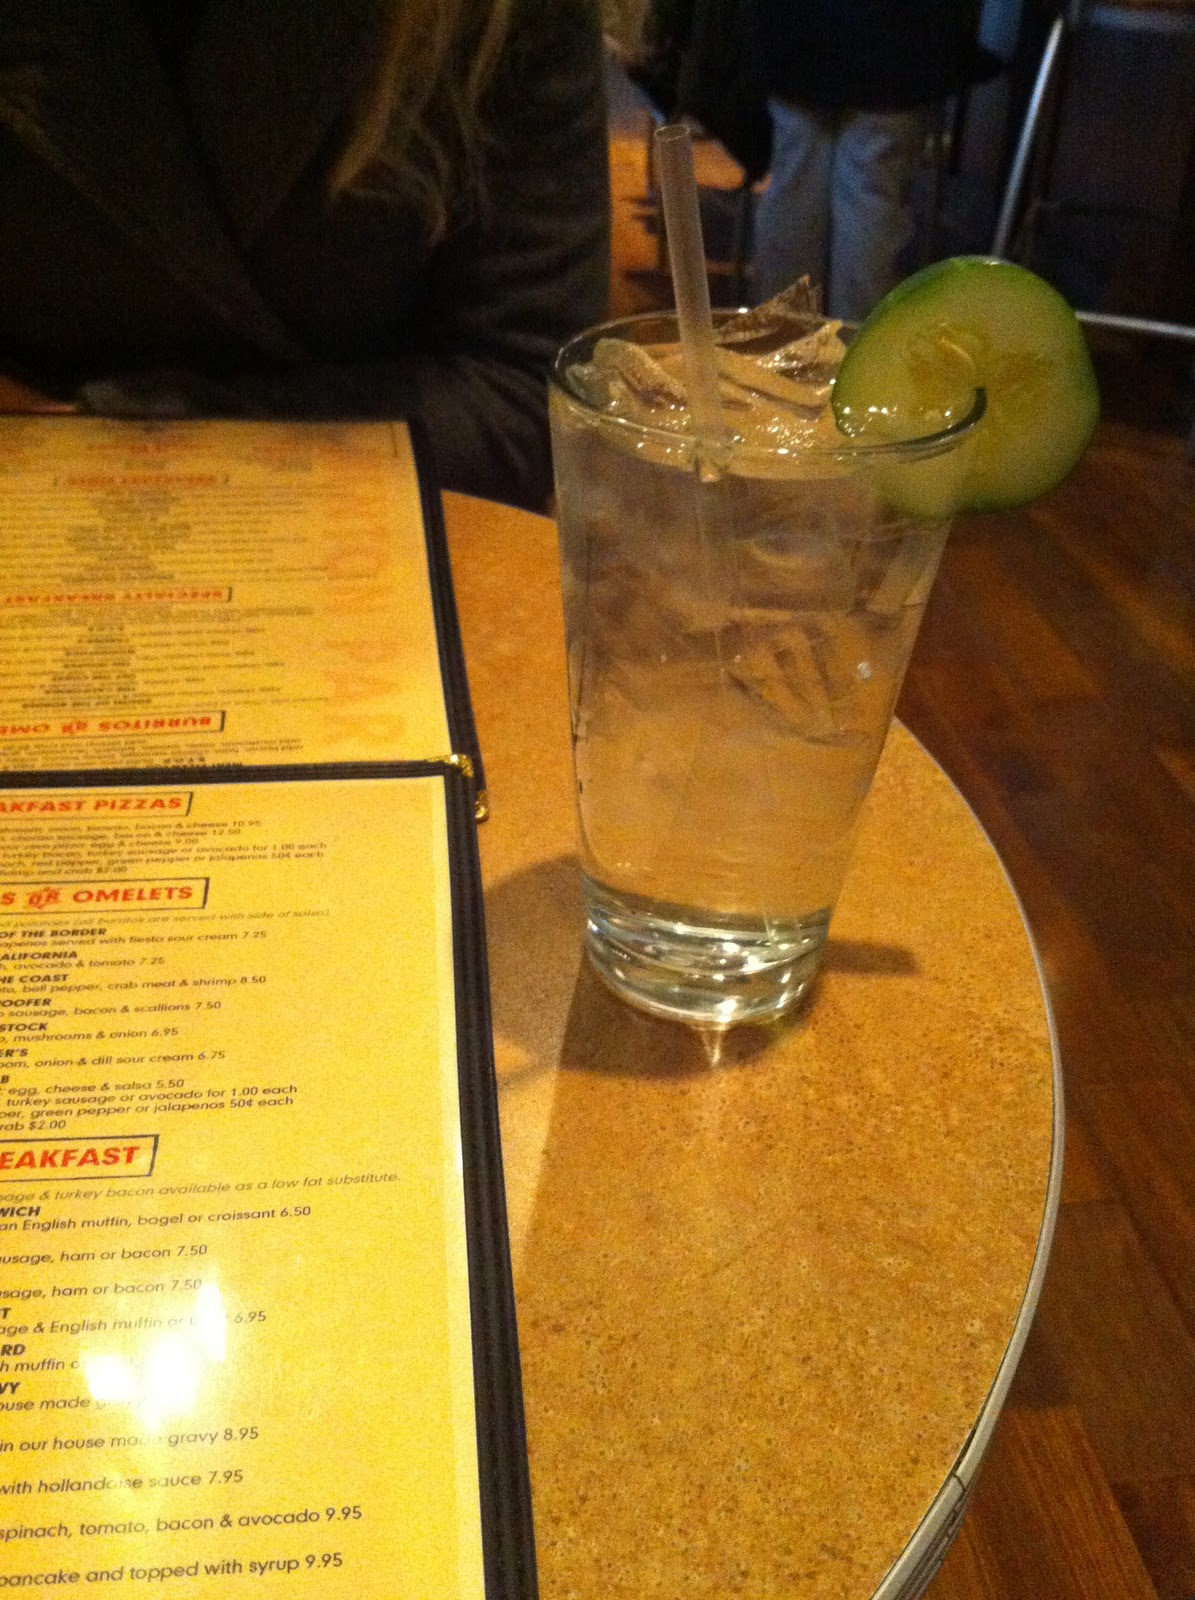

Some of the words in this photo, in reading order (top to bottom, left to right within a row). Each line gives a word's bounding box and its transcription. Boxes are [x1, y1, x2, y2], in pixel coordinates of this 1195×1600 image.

[98, 715, 212, 731] BURRITOS
[94, 797, 182, 811] PIZZAS
[72, 885, 193, 903] OMELETS
[21, 929, 46, 938] THE
[51, 928, 108, 938] BORDER
[100, 936, 126, 945] with
[129, 935, 164, 944] fiesta
[167, 934, 194, 943] sour
[197, 933, 238, 942] cream
[242, 930, 267, 940] 7.25
[1, 950, 78, 961] ALIFORNIA
[13, 960, 72, 970] avocado
[76, 959, 85, 968] &
[89, 958, 136, 967] tomato
[140, 956, 166, 966] 7.25
[19, 974, 69, 983] COAST
[23, 983, 47, 993] bell
[50, 982, 103, 994] pepper,
[107, 981, 138, 990] crab
[142, 980, 176, 989] meat
[179, 978, 189, 987] &
[192, 976, 237, 987] shrimp
[240, 975, 266, 985] 8.50
[0, 999, 52, 1008] OOFER
[9, 1009, 69, 1019] sausage,
[74, 1006, 117, 1016] bacon
[120, 1004, 130, 1013] &
[134, 1003, 191, 1013] scallions
[194, 1001, 222, 1010] 7.50
[13, 1032, 92, 1043] mushrooms
[96, 1031, 105, 1040] &
[109, 1029, 148, 1039] onion
[151, 1027, 179, 1037] 6.95
[35, 1058, 74, 1068] onion
[77, 1057, 87, 1066] &
[91, 1055, 112, 1066] dill
[116, 1056, 145, 1065] sour
[149, 1053, 194, 1063] cream
[198, 1050, 226, 1060] 6.75
[7, 1096, 51, 1108] turkey
[55, 1094, 116, 1106] sausage
[120, 1093, 135, 1102] or
[139, 1089, 203, 1101] avocado
[207, 1088, 226, 1098] for
[231, 1086, 259, 1097] 1.00
[262, 1084, 298, 1095] each
[8, 1086, 40, 1097] egg,
[45, 1083, 97, 1095] cheese
[100, 1081, 111, 1092] &
[114, 1080, 152, 1091] salsa
[155, 1078, 185, 1089] 5.50
[30, 1107, 73, 1120] green
[77, 1105, 131, 1117] pepper
[135, 1103, 150, 1113] or
[154, 1100, 226, 1113] jalapenos
[229, 1098, 254, 1109] 50¢
[258, 1096, 294, 1107] each
[28, 1119, 67, 1132] $2.00
[0, 1146, 140, 1170] EAKFAST
[39, 1189, 50, 1200] &
[54, 1188, 103, 1201] turkey
[106, 1187, 155, 1198] bacon
[159, 1181, 231, 1196] available
[235, 1183, 253, 1192] as
[257, 1180, 268, 1190] a
[271, 1179, 300, 1189] low
[303, 1176, 323, 1187] fat
[327, 1172, 401, 1186] substitute.
[22, 1217, 77, 1232] English
[81, 1216, 133, 1229] muffin,
[137, 1213, 184, 1227] bagel
[187, 1213, 204, 1223] or
[207, 1209, 276, 1222] croissant
[280, 1205, 312, 1218] 6.50
[0, 1254, 54, 1266] usage,
[60, 1250, 96, 1262] ham
[100, 1249, 117, 1260] or
[121, 1247, 171, 1259] bacon
[176, 1243, 208, 1257] 7.50
[0, 1288, 46, 1301] sage,
[51, 1285, 88, 1297] ham
[92, 1284, 109, 1295] or
[114, 1282, 165, 1295] bacon
[170, 1278, 202, 1292] 7.50
[33, 1321, 45, 1334] &
[49, 1319, 108, 1335] English
[112, 1316, 163, 1331] muffin
[167, 1317, 183, 1326] or
[234, 1310, 267, 1324] 6.95
[14, 1358, 66, 1372] muffin
[39, 1396, 91, 1410] made
[19, 1440, 48, 1451] our
[52, 1436, 106, 1450] house
[167, 1430, 219, 1448] gravy
[223, 1425, 259, 1441] 8.95
[149, 1474, 202, 1489] sauce
[208, 1469, 244, 1485] 7.95
[0, 1521, 73, 1544] spinach,
[79, 1520, 151, 1536] tomato,
[156, 1517, 215, 1533] bacon
[219, 1513, 233, 1528] &
[238, 1508, 321, 1528] avocado
[325, 1504, 363, 1523] 9.95
[86, 1565, 126, 1583] and
[130, 1560, 200, 1583] topped
[204, 1558, 244, 1576] with
[249, 1556, 301, 1577] syrup
[305, 1551, 344, 1569] 9.95
